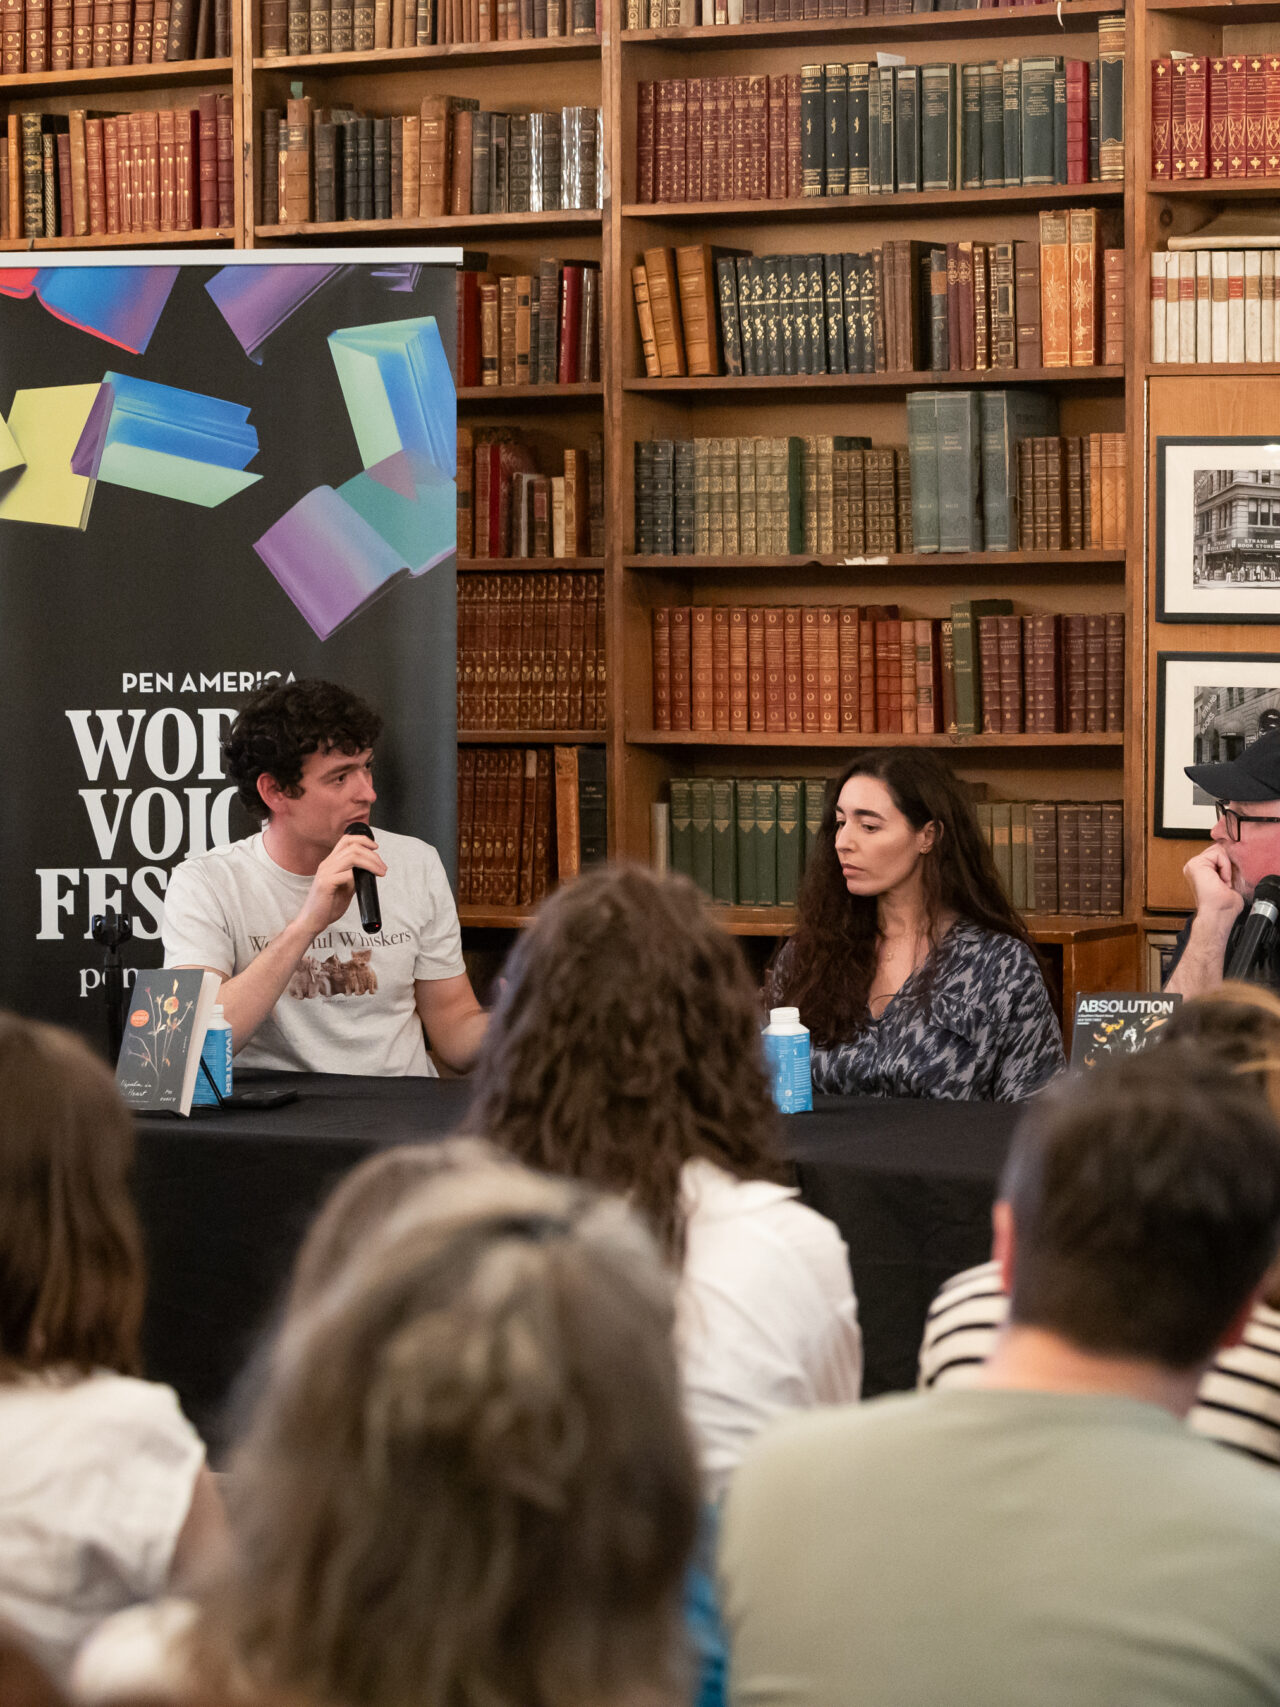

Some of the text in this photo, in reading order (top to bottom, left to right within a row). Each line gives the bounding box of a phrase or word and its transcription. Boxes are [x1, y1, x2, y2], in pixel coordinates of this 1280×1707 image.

[122, 672, 174, 693] PEN
[65, 707, 240, 782] WOR
[78, 786, 240, 861] VOIC
[337, 930, 413, 949] Whiskers
[1078, 999, 1174, 1014] ABSOLUTION
